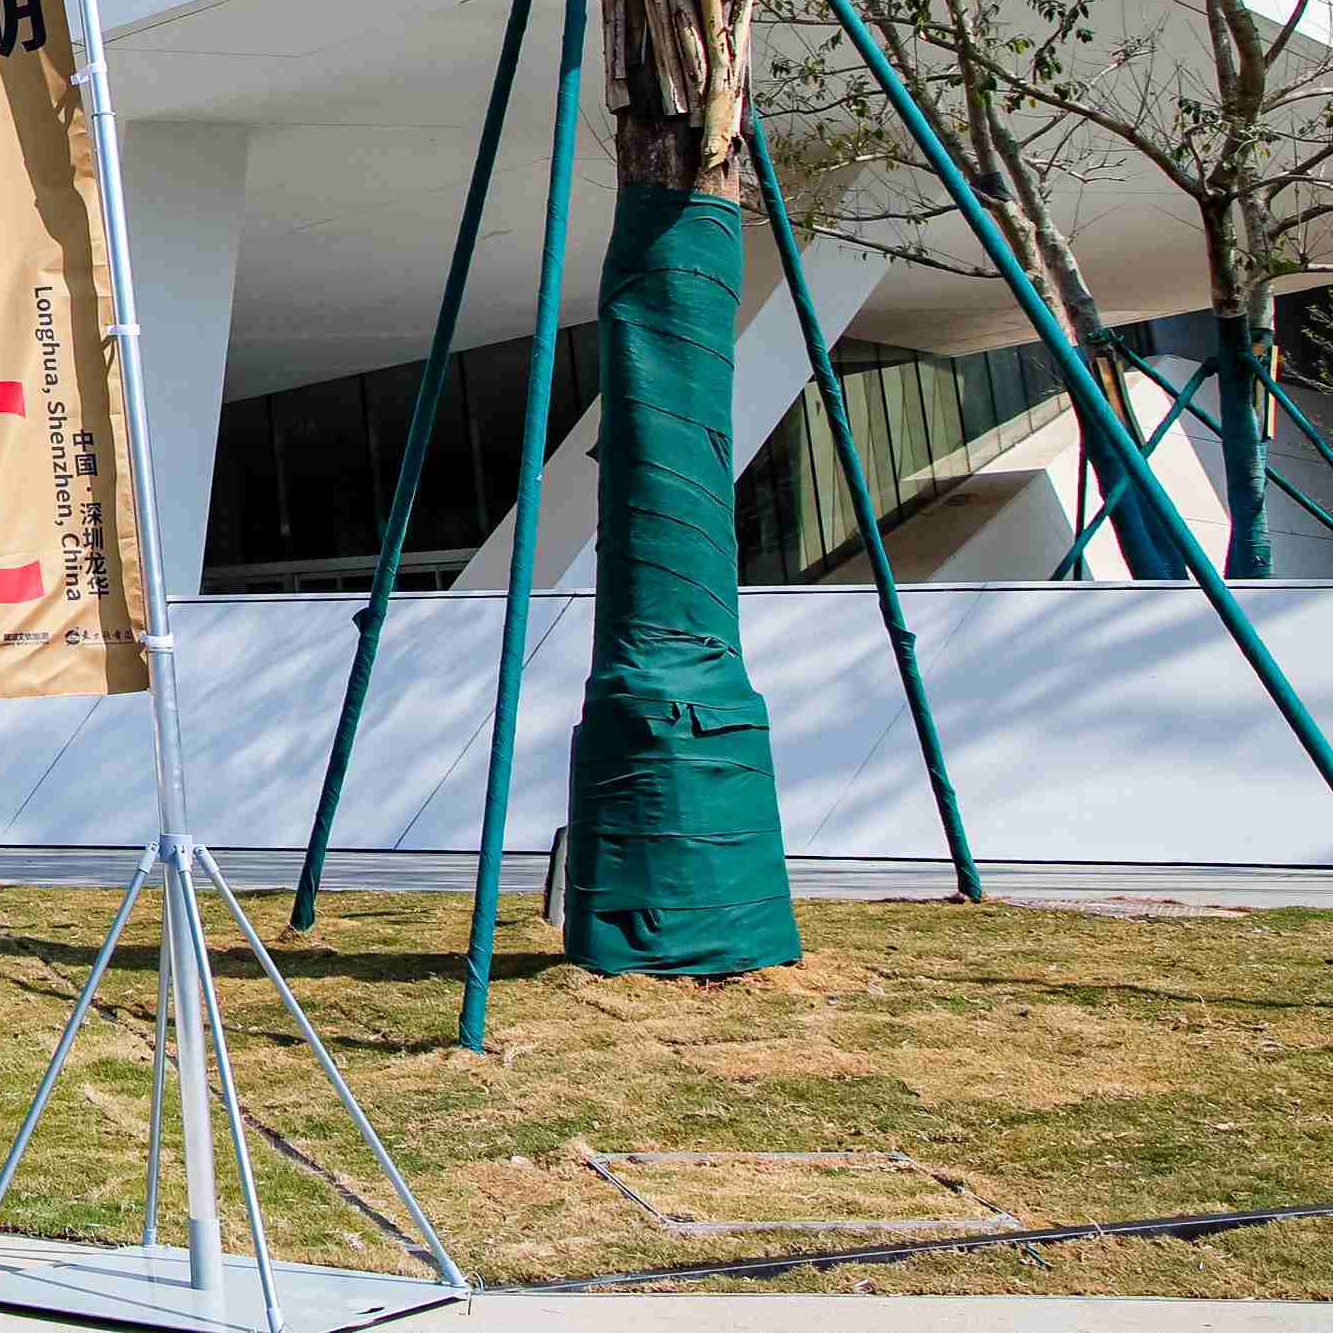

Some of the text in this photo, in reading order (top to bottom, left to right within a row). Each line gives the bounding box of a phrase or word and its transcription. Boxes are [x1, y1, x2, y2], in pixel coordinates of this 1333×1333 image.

[34, 286, 81, 602] Longhua, Shenzhen, China
